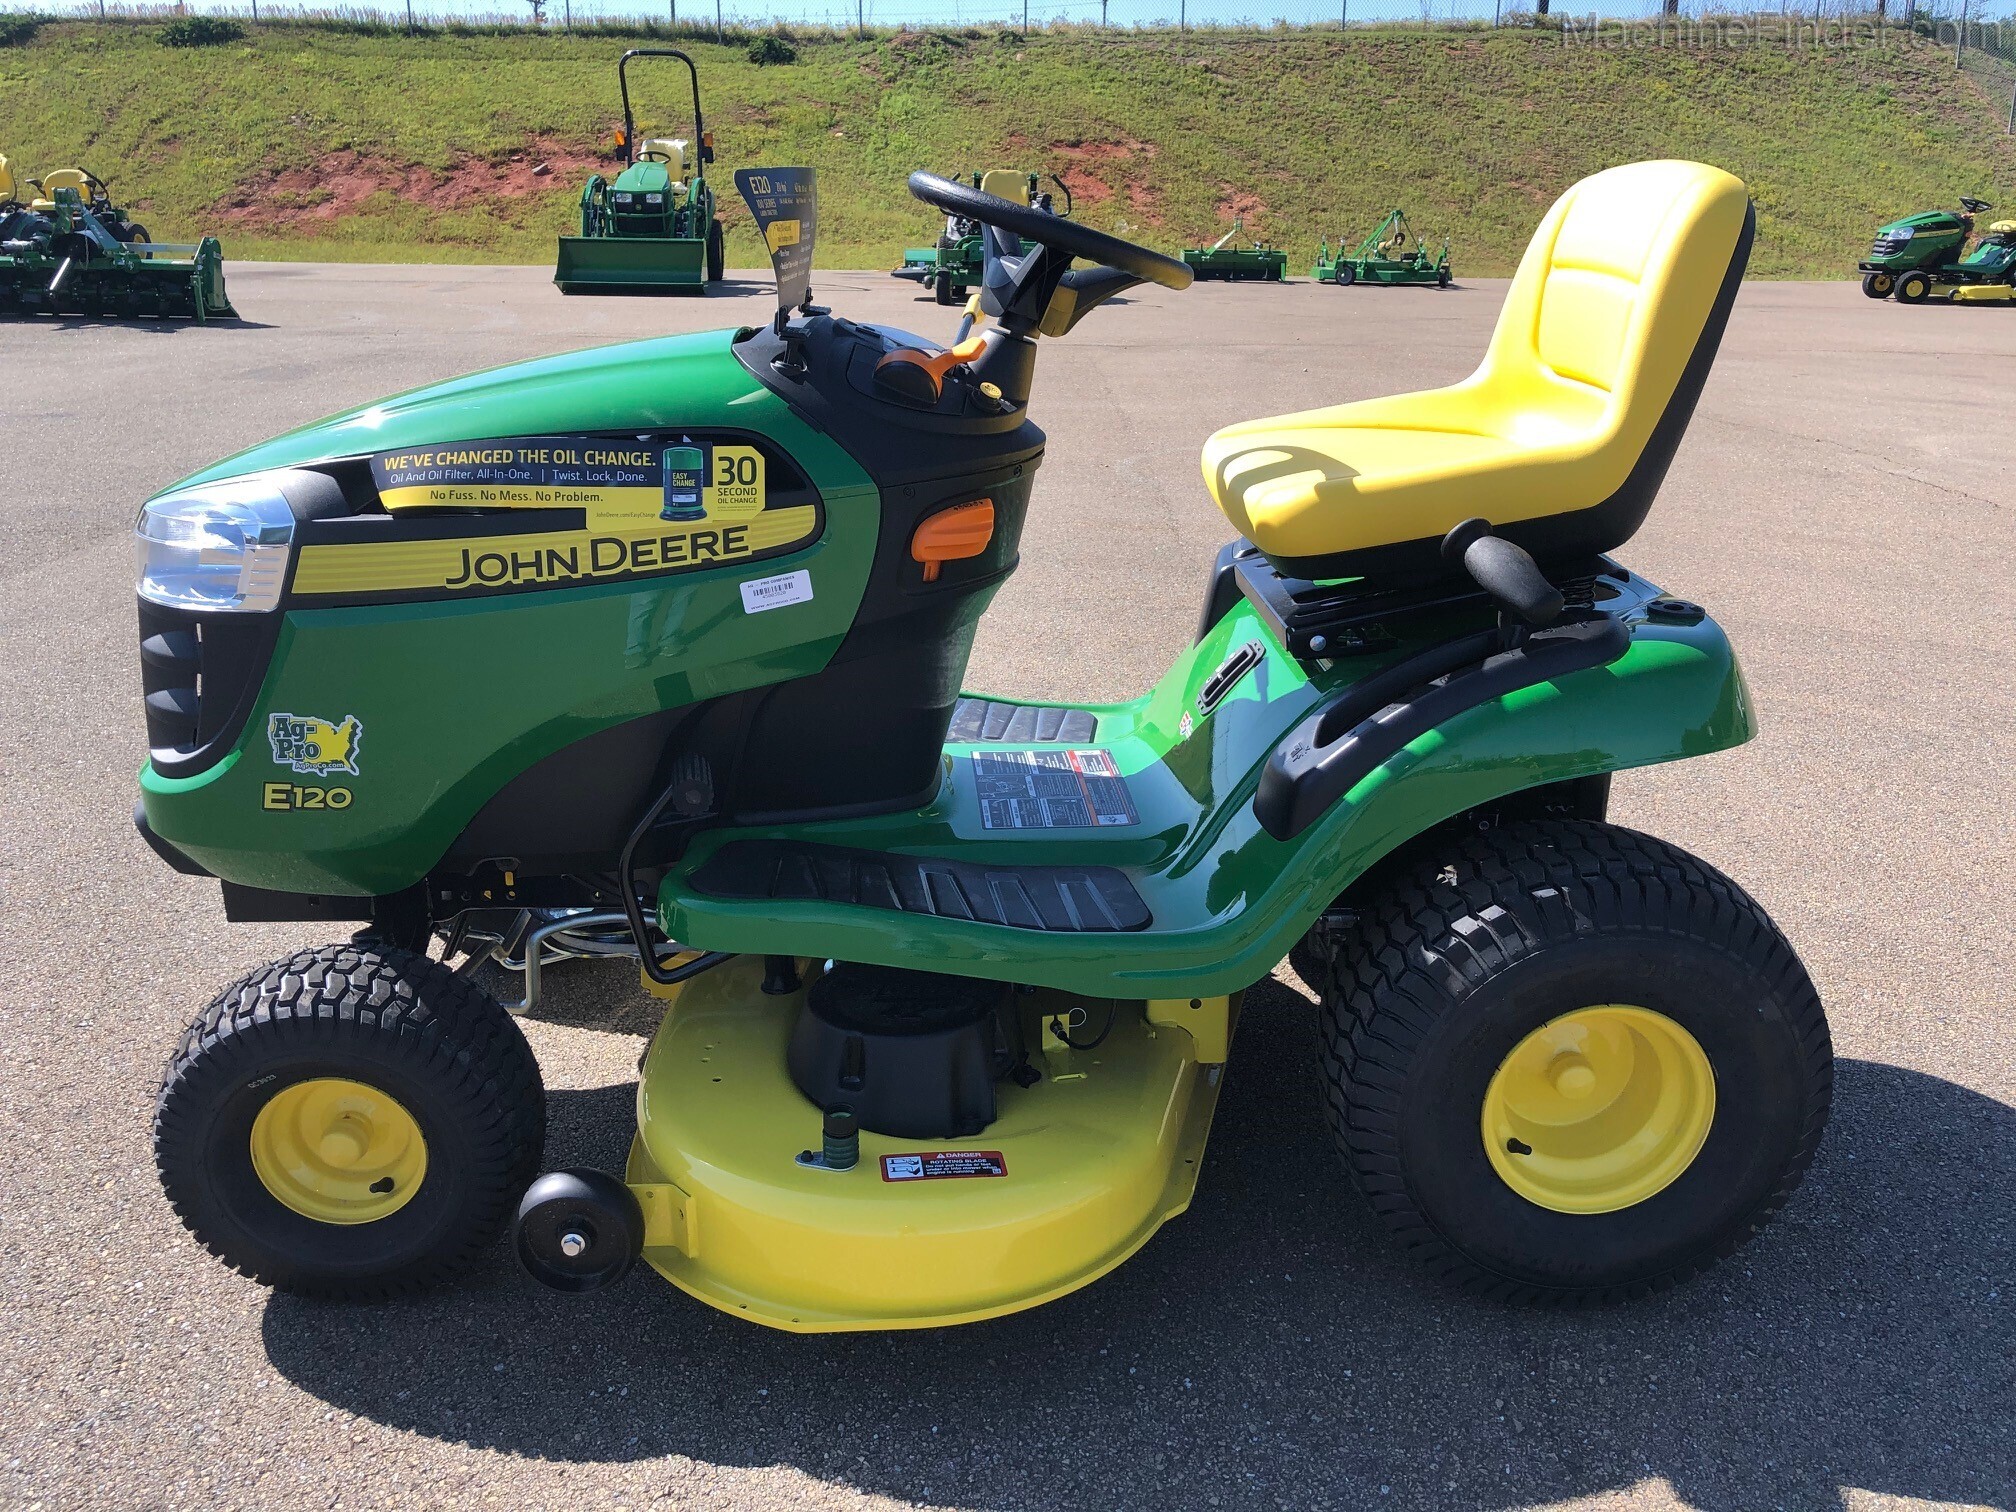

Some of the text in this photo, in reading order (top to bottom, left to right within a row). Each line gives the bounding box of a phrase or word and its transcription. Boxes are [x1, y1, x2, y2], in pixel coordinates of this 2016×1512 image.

[748, 176, 771, 194] E120
[384, 448, 656, 471] WE'VE CHANGED THE OIL CHANGE.
[390, 468, 648, 484] Oil And Oil Filter, All-In-One. Twist. Lock. Done.
[718, 456, 757, 486] 30
[430, 490, 603, 502] No Fuss. No Mess. No Problem.
[718, 488, 757, 496] SECOND
[446, 526, 750, 584] JOHN DEERE
[770, 576, 795, 584] COMPANIES
[274, 718, 316, 742] Ag-
[276, 738, 320, 760] Pro
[296, 762, 344, 770] AgProCo.com
[264, 783, 352, 809] E120
